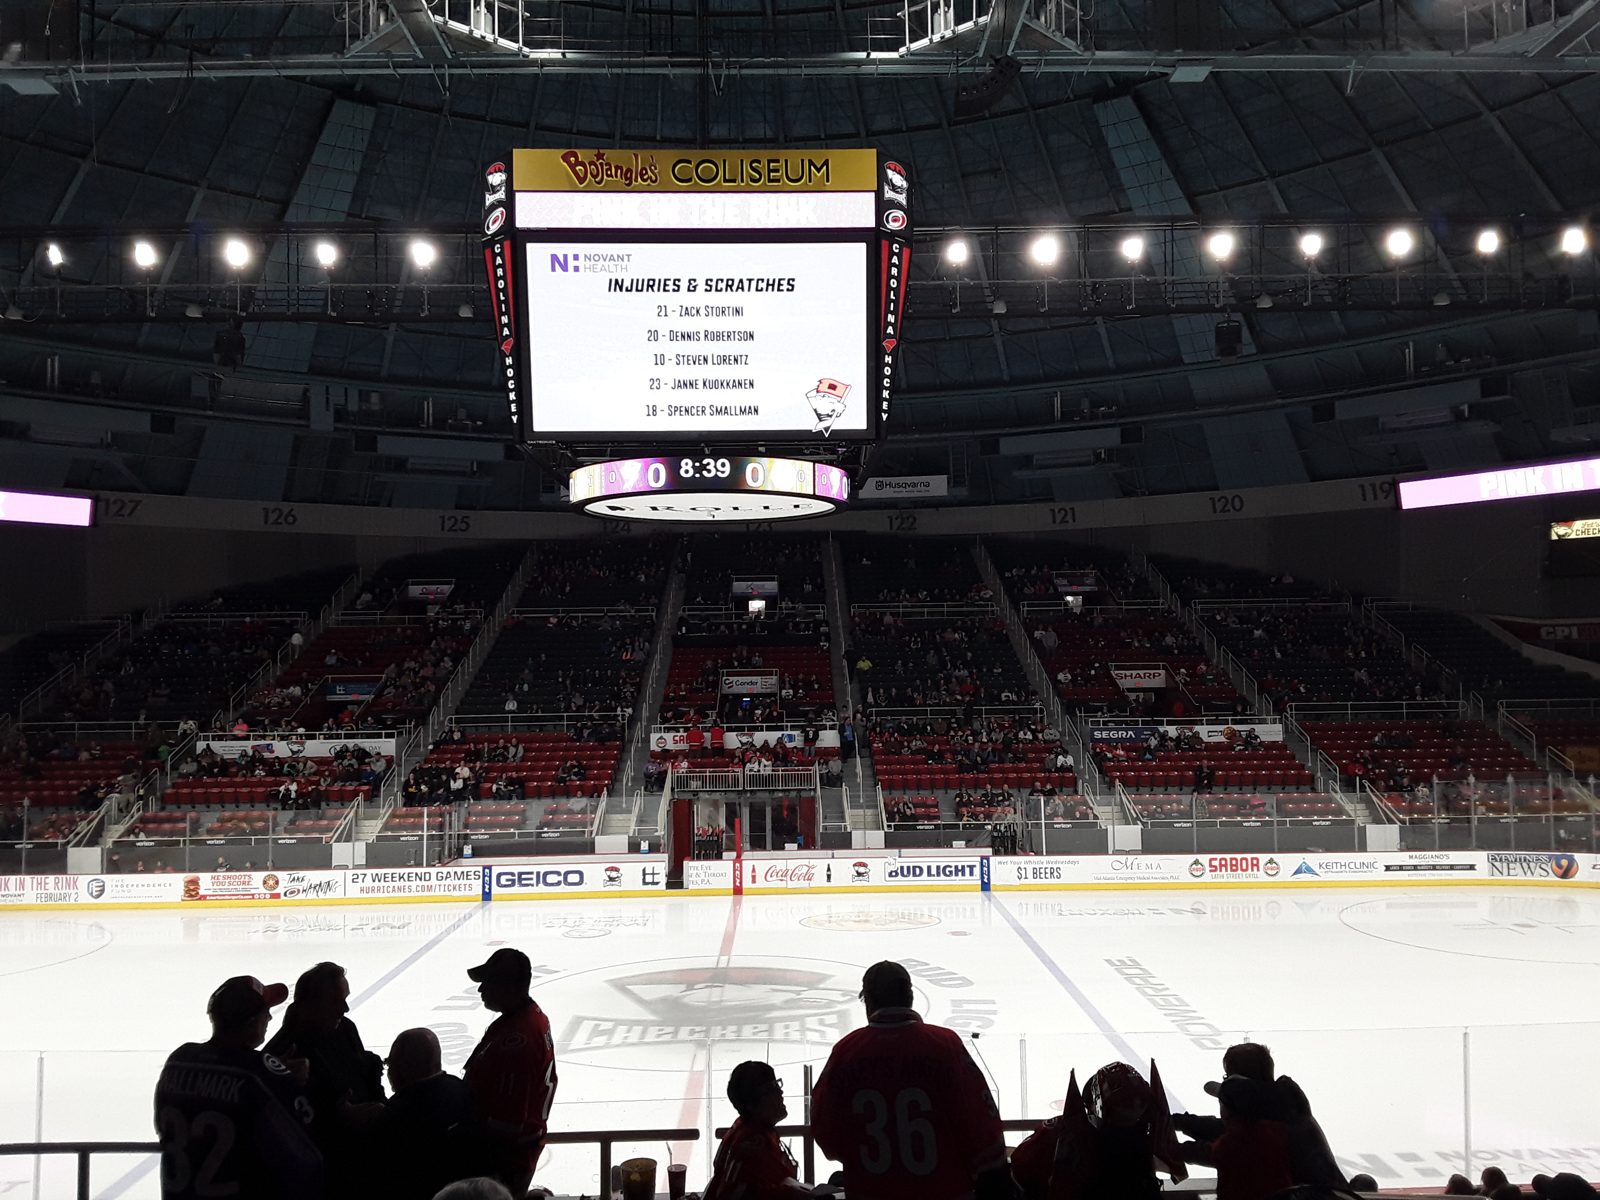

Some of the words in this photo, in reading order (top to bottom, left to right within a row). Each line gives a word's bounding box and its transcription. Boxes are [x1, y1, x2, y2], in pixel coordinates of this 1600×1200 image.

[561, 150, 658, 187] Bojangle's
[672, 158, 830, 186] COLISEUM
[584, 254, 632, 263] NOVANT
[584, 264, 628, 272] HEALTH
[608, 279, 681, 292] INJURIES
[687, 279, 699, 292] &
[704, 278, 796, 292] SCRATCHES
[657, 305, 668, 317] 21
[647, 330, 659, 342] 20
[654, 354, 666, 366] 10
[649, 378, 661, 390] 23
[646, 405, 658, 417] 18
[647, 463, 666, 488] 0
[680, 459, 730, 478] 8:39
[746, 463, 765, 488] 0
[884, 481, 931, 490] Husqvarna
[1479, 467, 1545, 498] PINK
[1552, 463, 1585, 490] IN
[1358, 481, 1395, 502] 119
[103, 498, 142, 518] 127
[1209, 495, 1244, 514] 120
[262, 506, 297, 526] 126
[887, 514, 917, 531] 122
[1050, 507, 1076, 524] 121
[439, 514, 471, 533] 125
[1114, 671, 1161, 681] SHARP
[1093, 730, 1137, 740] SEGRA
[1208, 857, 1261, 873] SABOR
[1318, 861, 1347, 870] KEITH
[1348, 861, 1379, 870] CLINIC
[1488, 854, 1552, 863] EYEWITNESS
[351, 873, 368, 884] 27
[371, 871, 432, 882] WEEKEND
[435, 869, 481, 882] GAMES
[888, 865, 925, 879] BUD
[927, 864, 977, 878] LIGHT
[1017, 866, 1029, 881] $1
[1032, 866, 1062, 880] BEERS
[1490, 862, 1550, 878] NEWS
[15, 877, 26, 892] IN
[30, 876, 50, 891] THE
[54, 876, 80, 890] RINK
[286, 872, 306, 885] TAKE
[496, 870, 585, 888] GEICO
[359, 883, 474, 895] HURRICANES.COM/TICKETS
[36, 891, 72, 903] FEBRUARY
[74, 891, 80, 902] 2
[1103, 956, 1228, 1051] POWERADE
[566, 1012, 843, 1053] CHECKERS
[851, 1086, 941, 1177] 36
